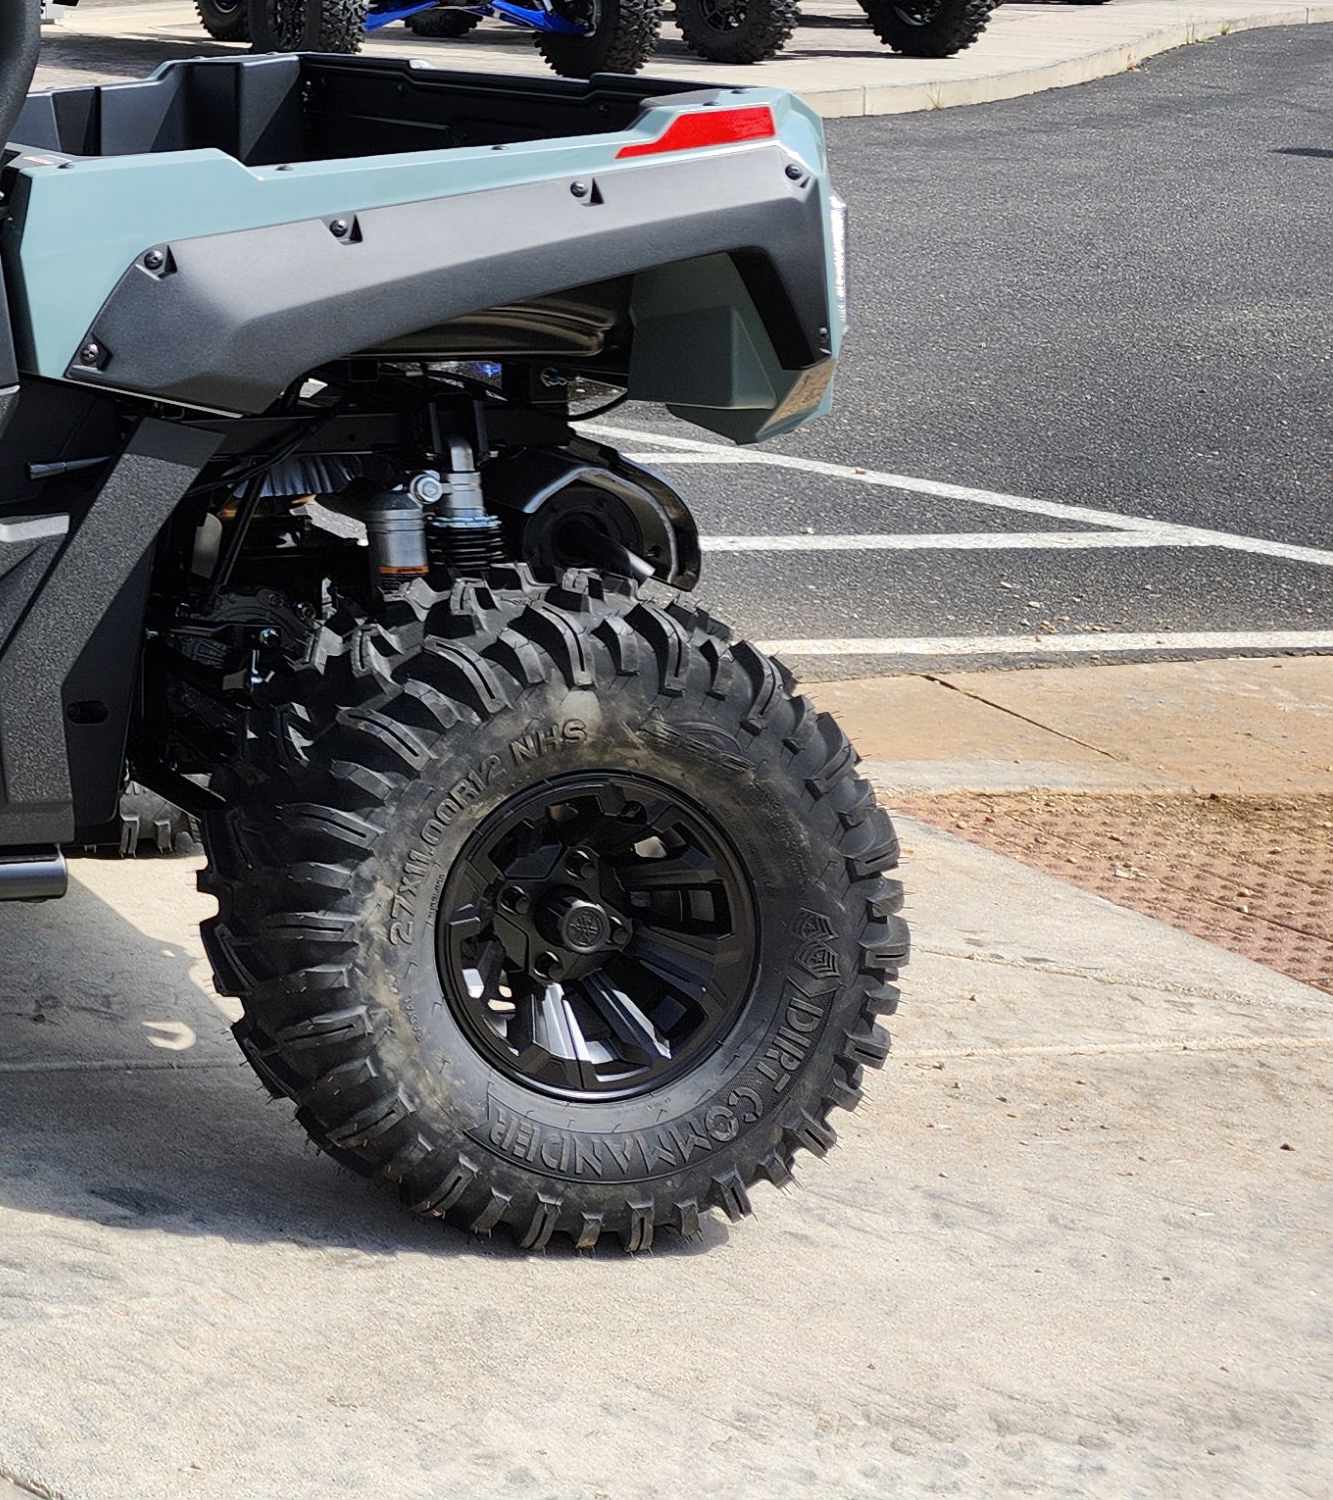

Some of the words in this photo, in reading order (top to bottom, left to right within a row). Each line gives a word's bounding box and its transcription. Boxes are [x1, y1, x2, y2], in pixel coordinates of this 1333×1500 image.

[510, 719, 589, 766] NHS
[755, 997, 825, 1093] DIRT
[489, 1086, 765, 1177] COMMANDER
